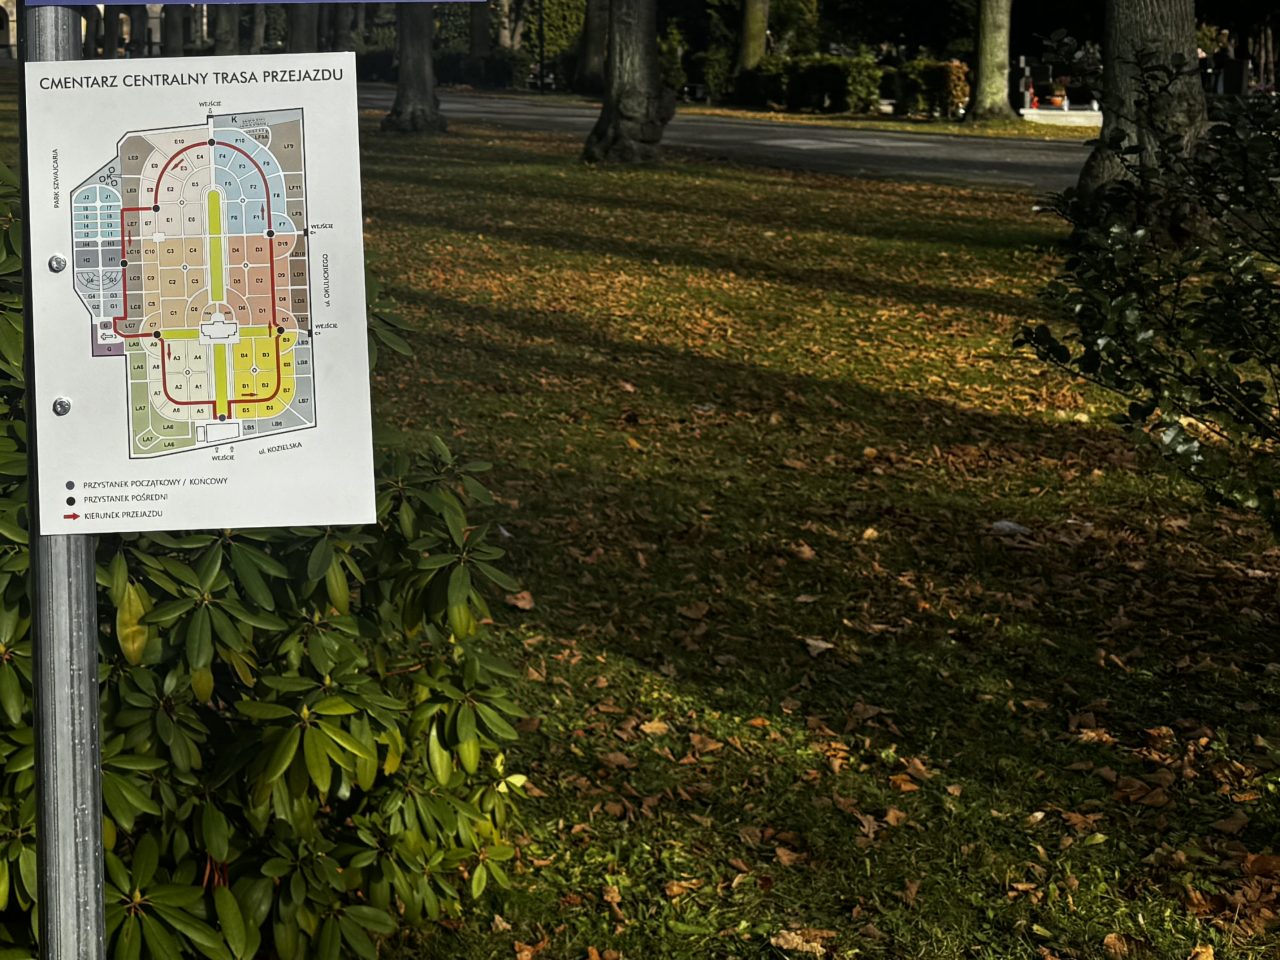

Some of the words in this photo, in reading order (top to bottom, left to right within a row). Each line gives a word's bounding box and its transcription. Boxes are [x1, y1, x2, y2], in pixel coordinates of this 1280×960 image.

[39, 76, 118, 90] CMENTARZ
[122, 73, 209, 87] CENTRALNY
[213, 72, 258, 85] TRASA
[263, 69, 343, 83] PRZEJAZDU
[322, 253, 330, 299] OKULICKIEGO
[267, 441, 303, 454] KOZIELSKA
[83, 481, 129, 489] PRZYSTANEK
[131, 478, 181, 488] POCZĄTKOWY
[84, 495, 130, 503] PRZYSTANEK
[131, 492, 168, 502] POŚREDNI
[84, 511, 120, 520] KIERUNEK
[122, 510, 163, 518] PRZEJAZDU
